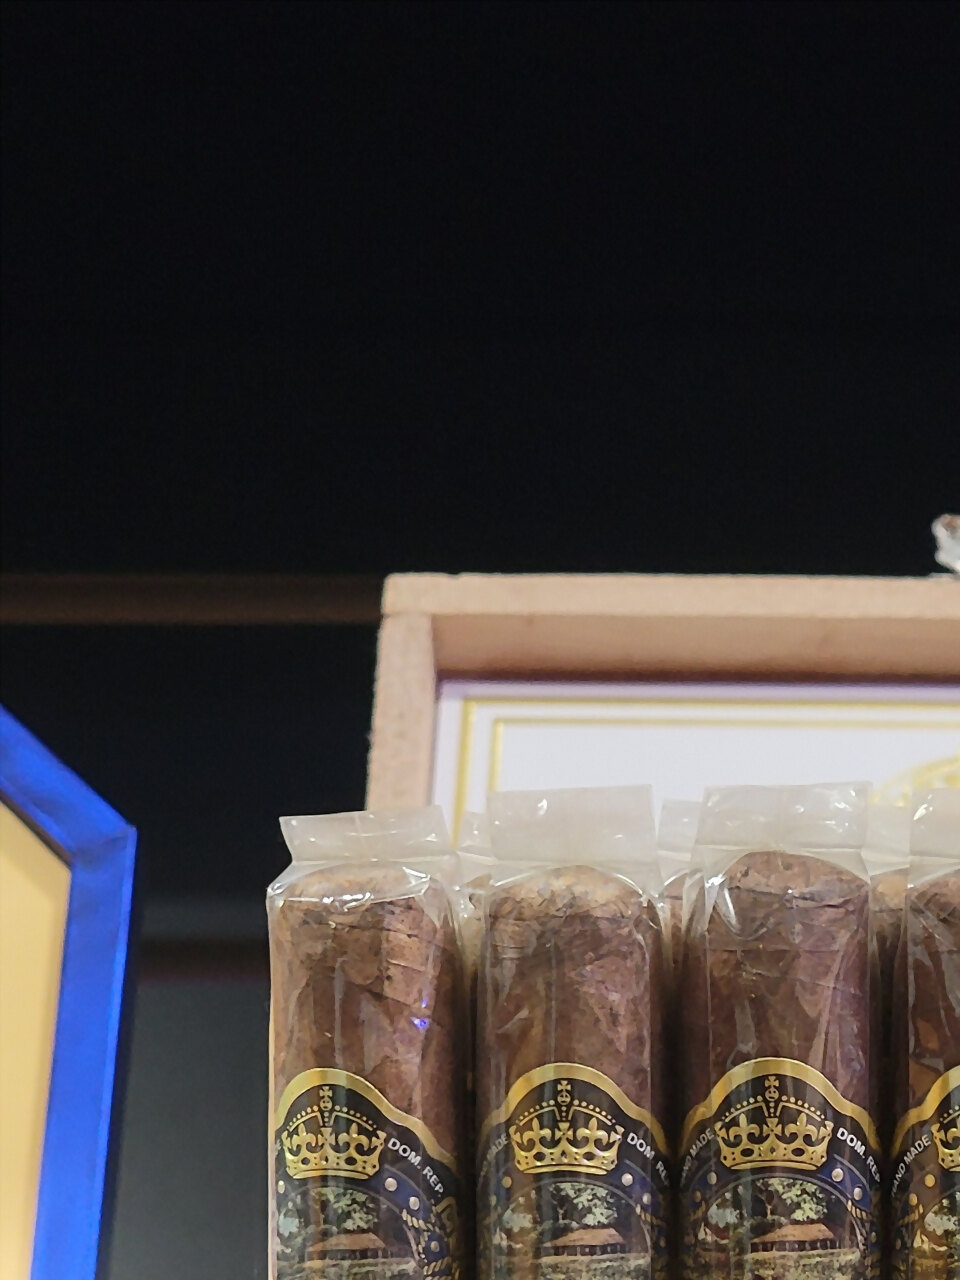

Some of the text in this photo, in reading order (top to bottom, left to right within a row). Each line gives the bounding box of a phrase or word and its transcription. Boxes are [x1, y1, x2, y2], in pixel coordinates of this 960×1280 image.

[388, 1138, 421, 1169] DOM.
[690, 1128, 715, 1157] MADE
[837, 1127, 866, 1158] DOM.
[903, 1134, 932, 1165] MADE
